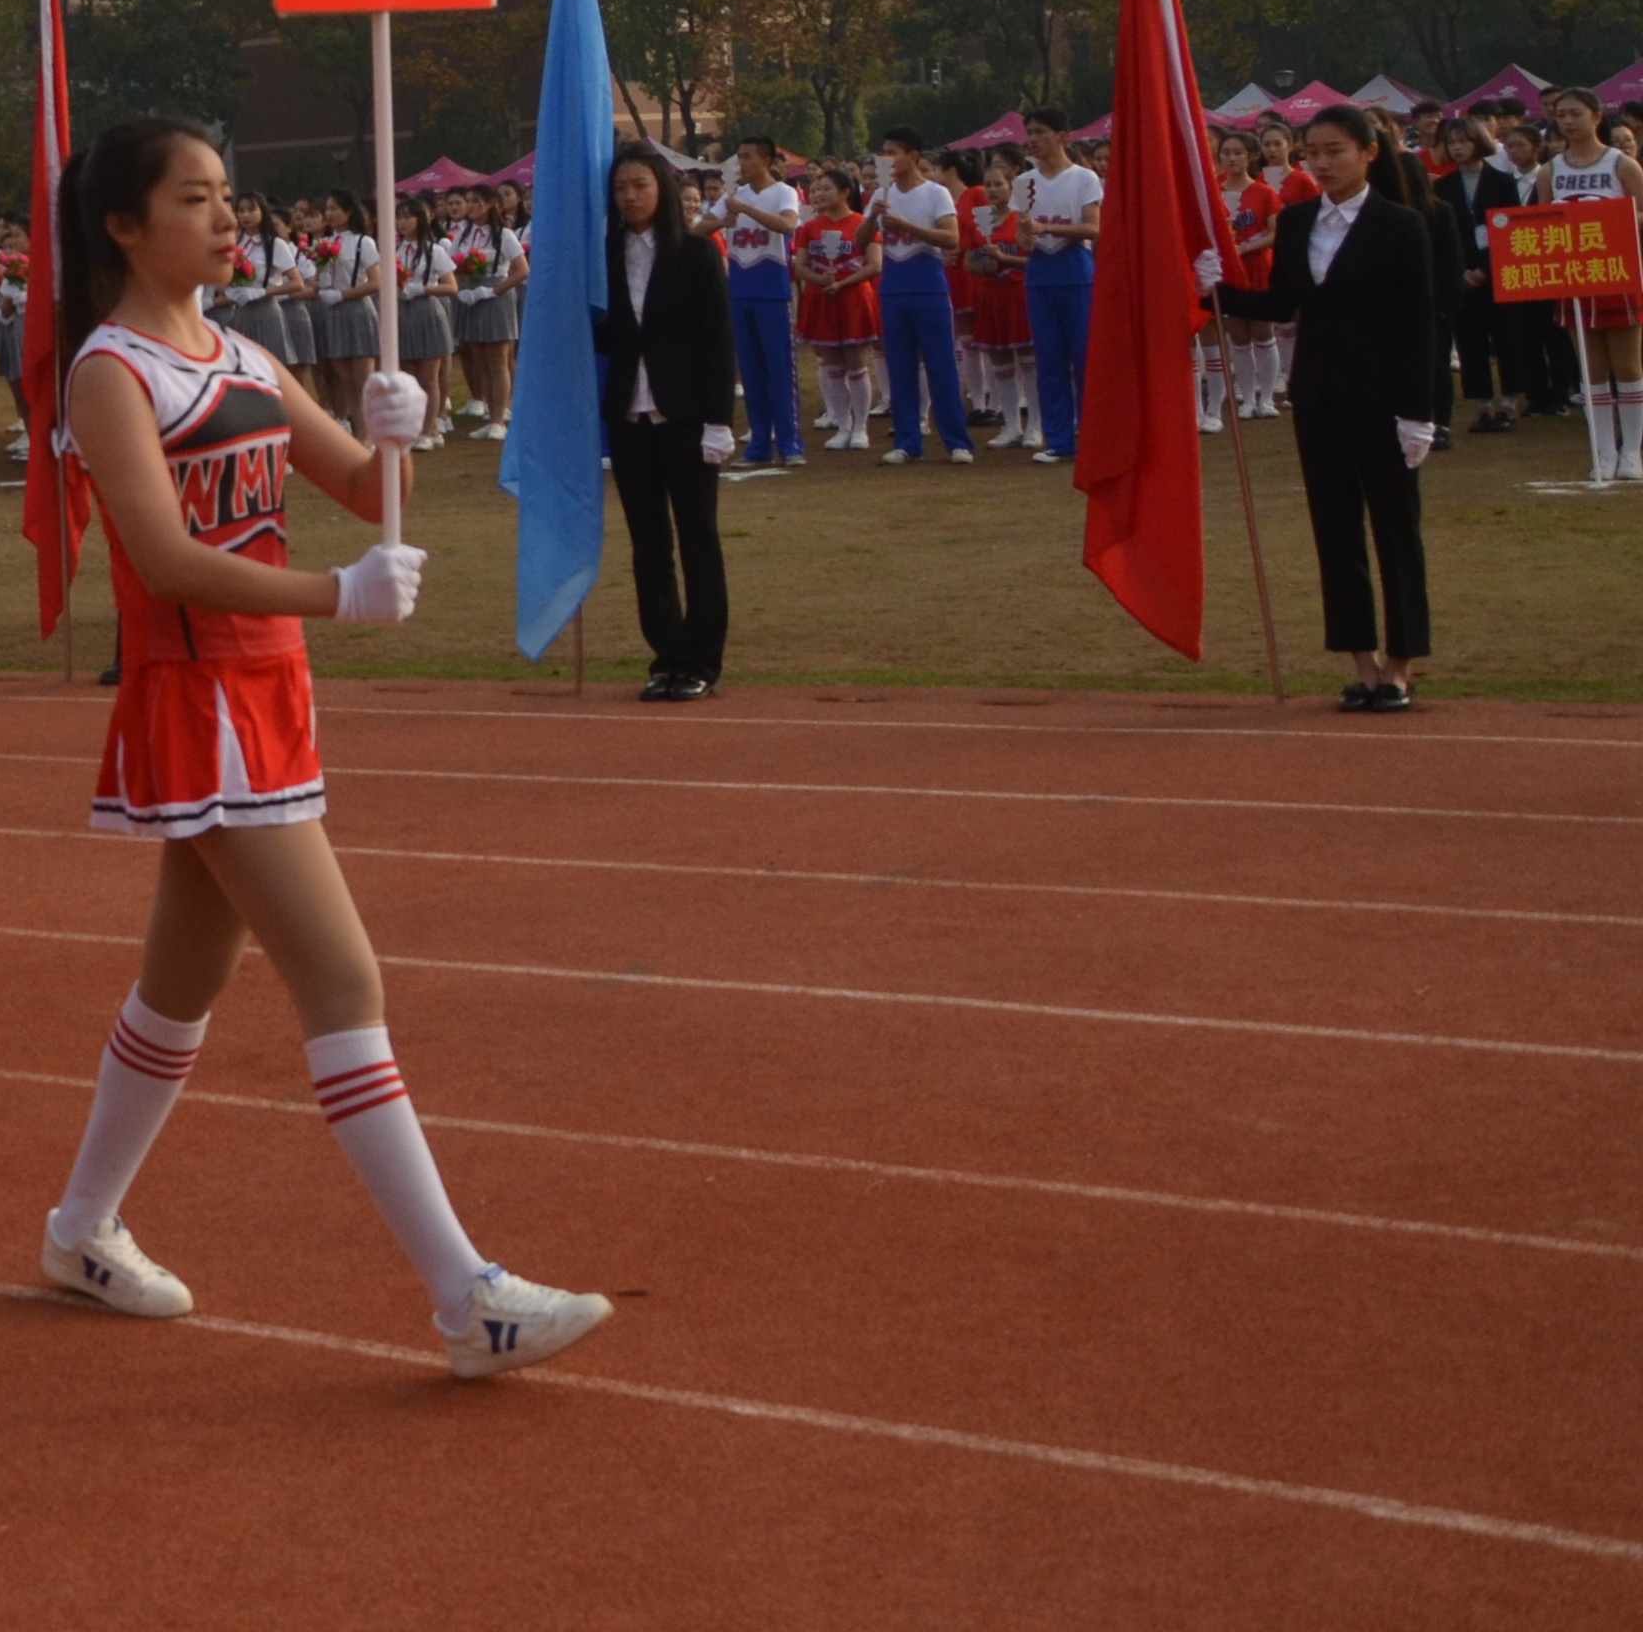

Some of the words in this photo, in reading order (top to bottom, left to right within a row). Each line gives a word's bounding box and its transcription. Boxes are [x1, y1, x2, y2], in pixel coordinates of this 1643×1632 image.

[1555, 173, 1612, 190] CHEER
[1510, 221, 1607, 256] 裁判员
[1501, 256, 1630, 290] 教职工代表队
